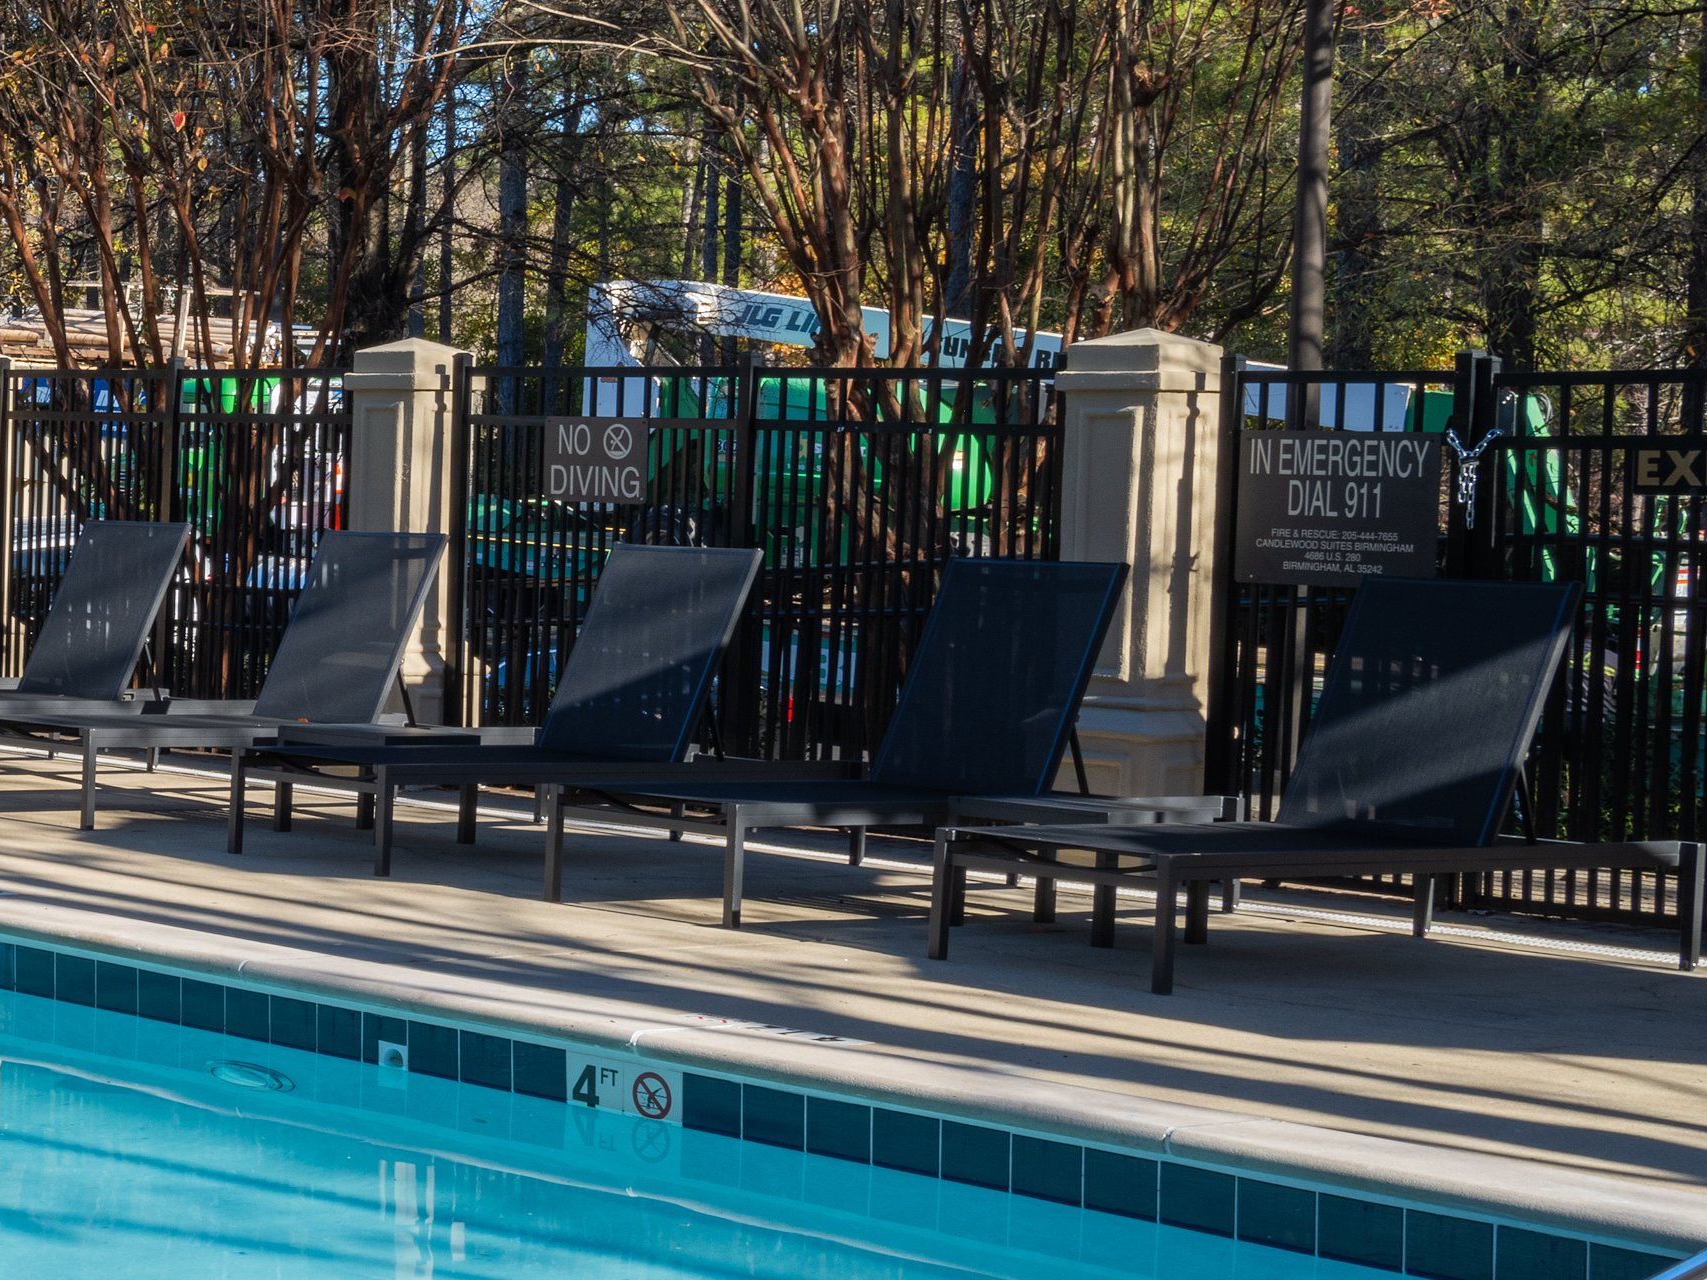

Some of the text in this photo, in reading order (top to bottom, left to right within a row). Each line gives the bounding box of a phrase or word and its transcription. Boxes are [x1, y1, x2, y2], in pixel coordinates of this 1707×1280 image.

[558, 423, 591, 456] NO
[1250, 438, 1430, 478] IN EMERGENCY
[1637, 449, 1707, 487] EX
[550, 464, 641, 499] DIVING
[1288, 480, 1382, 518] DIAL 911
[1255, 538, 1415, 553] CANDLEWOOD SUITES BIRMINGHAM
[1271, 528, 1291, 538] FIRE
[1292, 528, 1299, 538] &
[1301, 529, 1339, 540] RESCUE:
[1282, 561, 1383, 575] BIRMINGHAM, AL 35242
[1326, 552, 1343, 562] U.S.
[1345, 552, 1361, 562] 280
[572, 1064, 619, 1108] 4 FT
